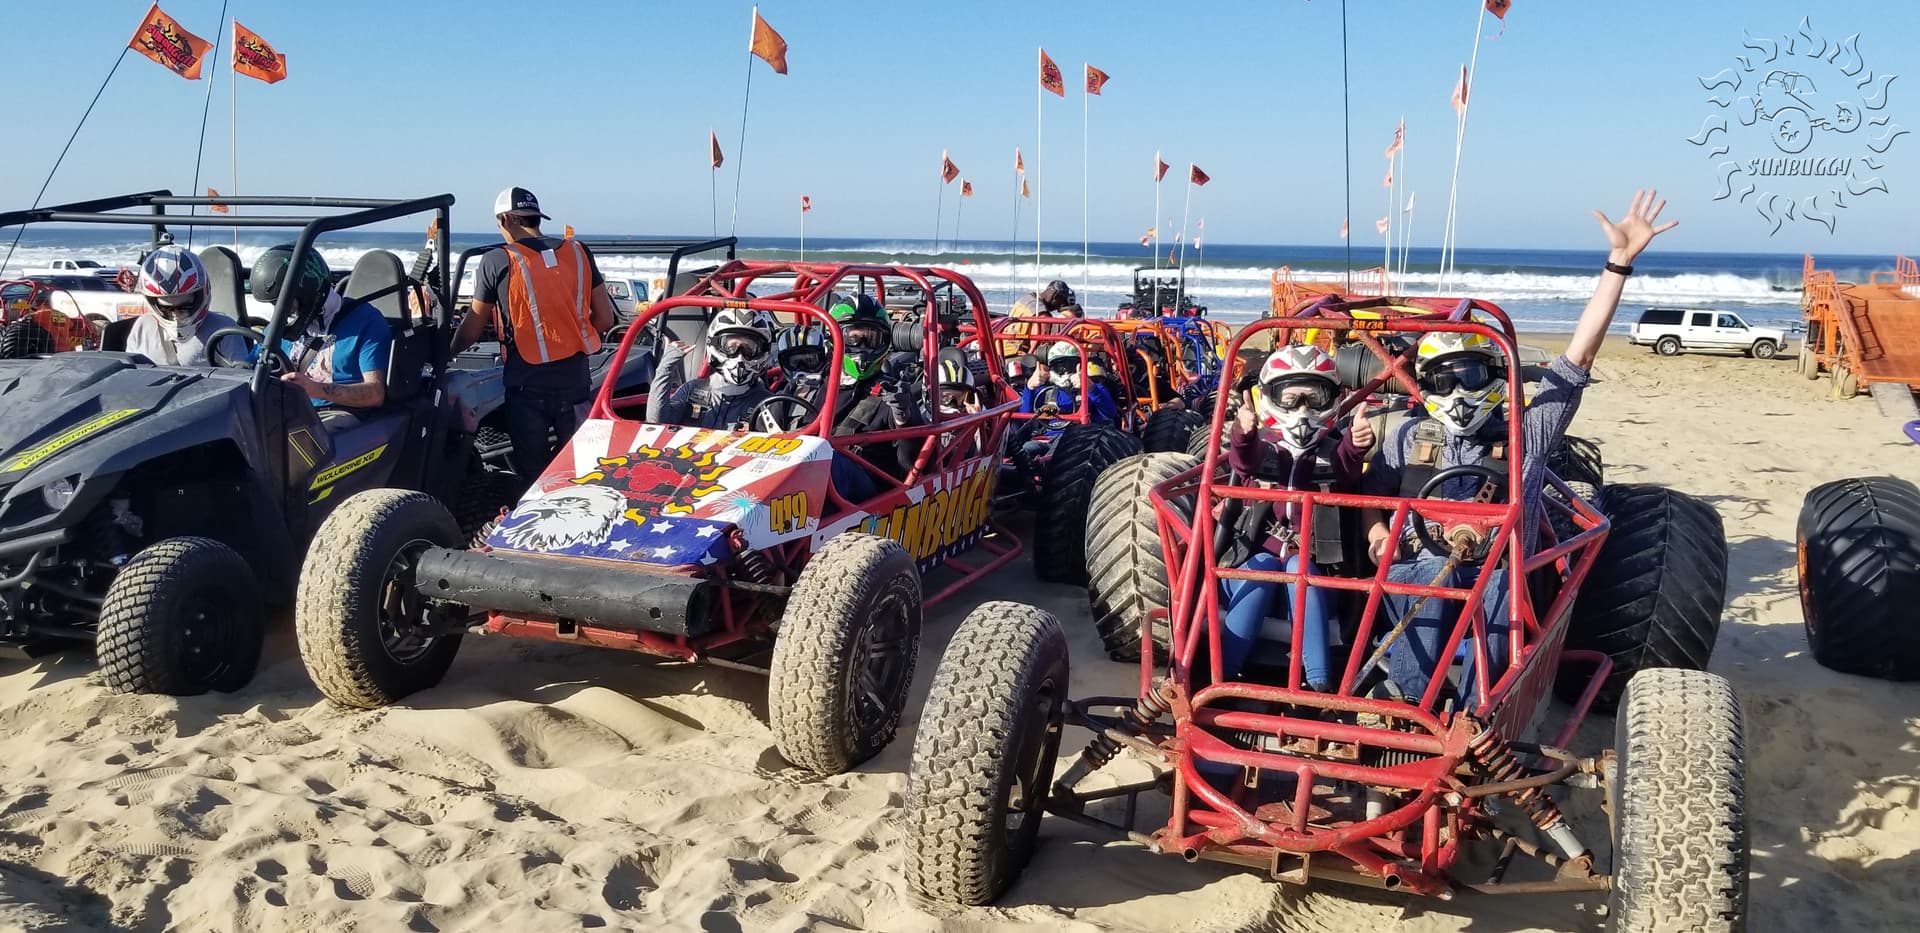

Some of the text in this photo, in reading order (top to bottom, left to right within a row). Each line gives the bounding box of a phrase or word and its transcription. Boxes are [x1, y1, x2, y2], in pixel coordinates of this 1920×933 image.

[735, 436, 804, 456] 419
[317, 457, 362, 484] WOLVERINE
[769, 490, 808, 536] 419
